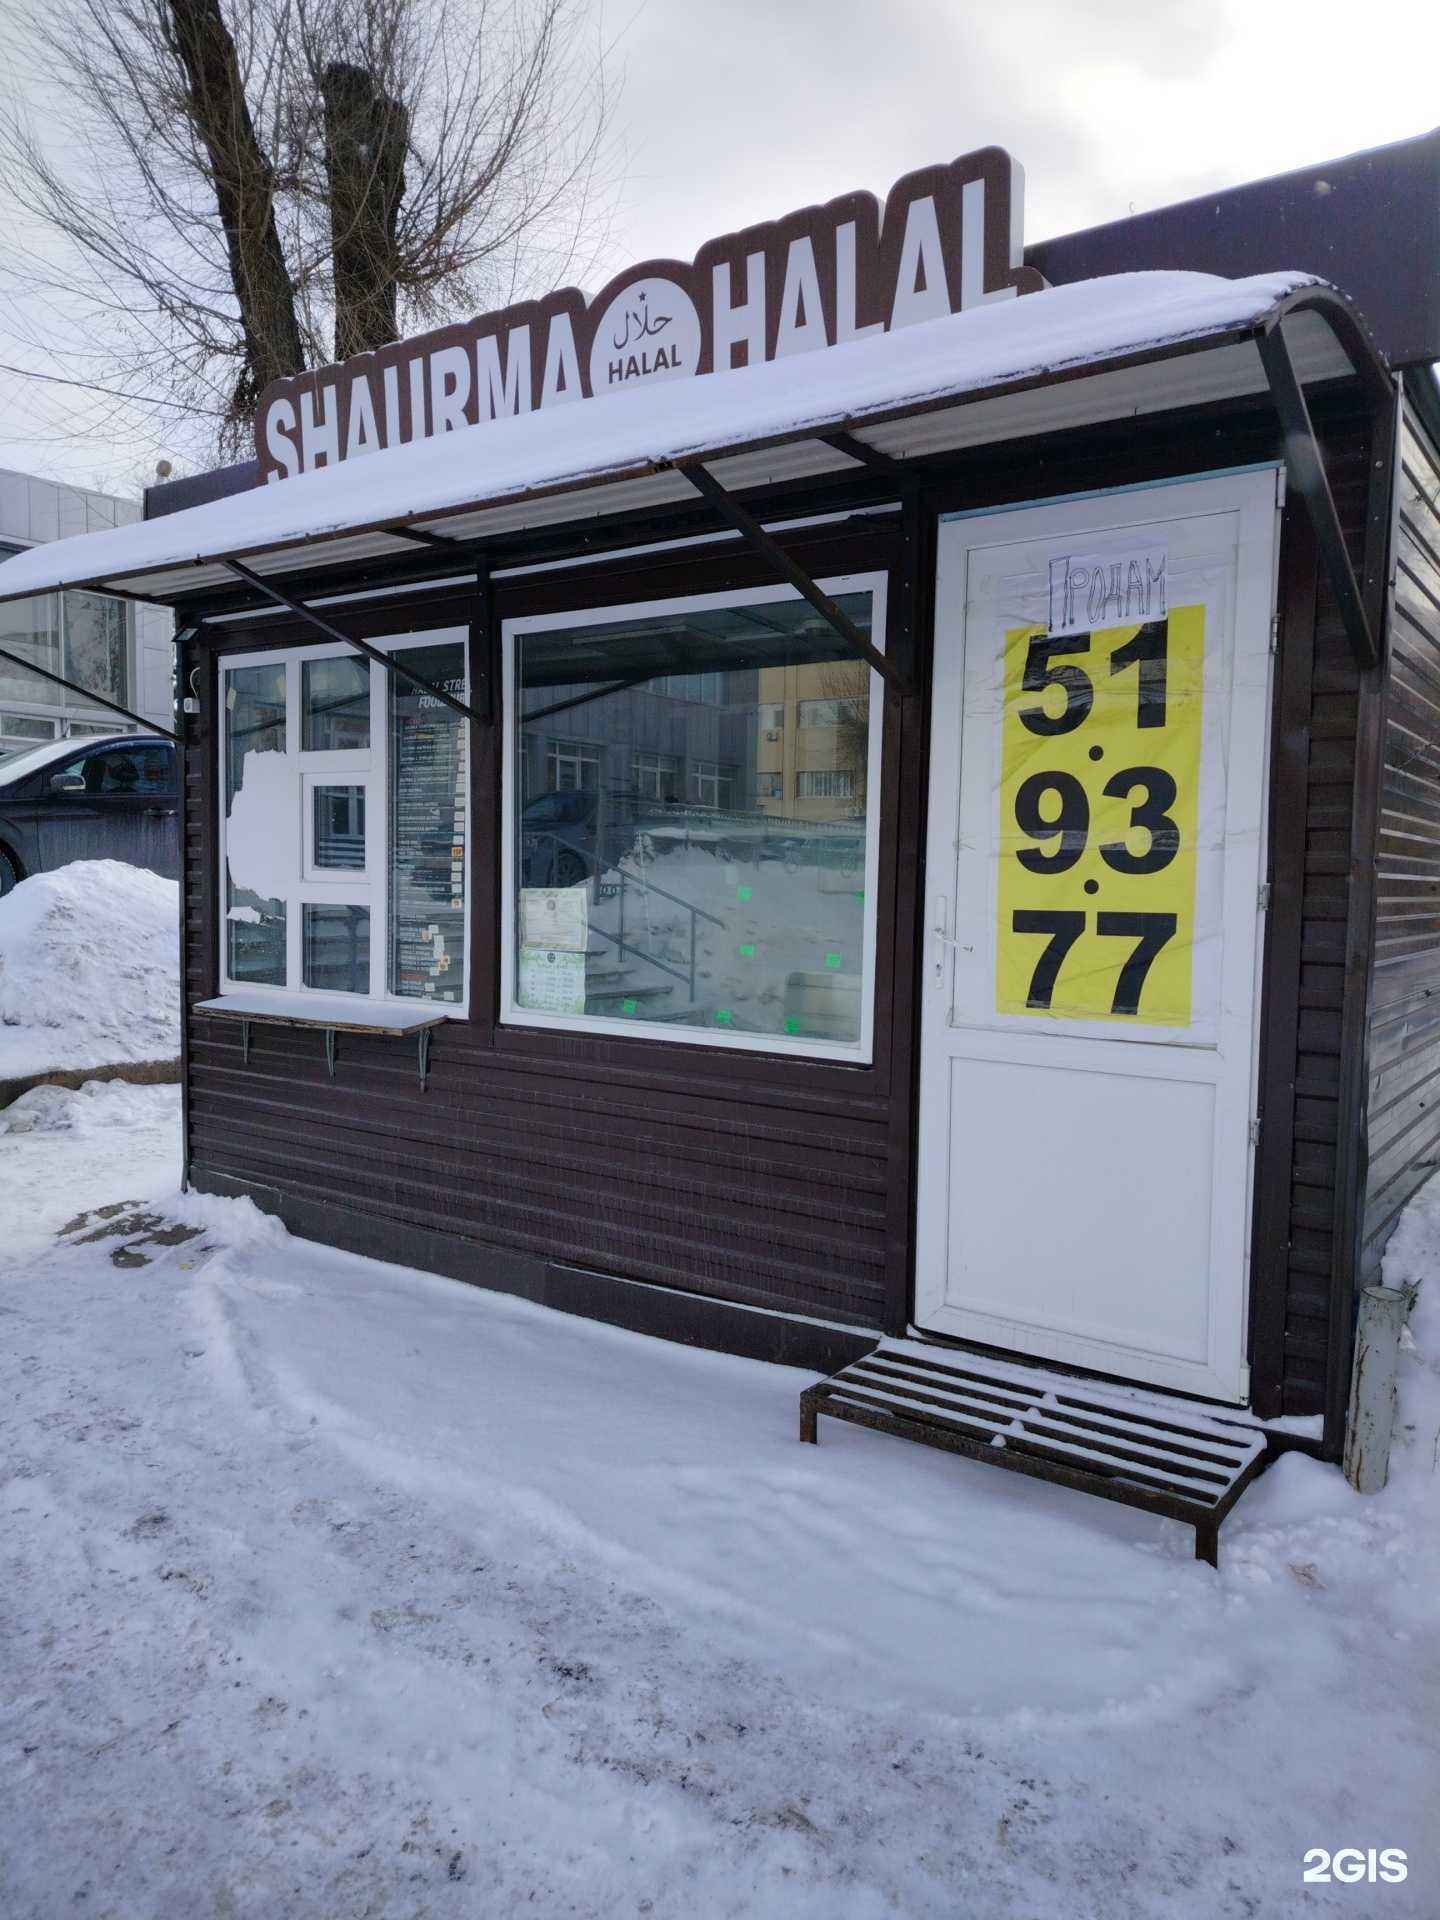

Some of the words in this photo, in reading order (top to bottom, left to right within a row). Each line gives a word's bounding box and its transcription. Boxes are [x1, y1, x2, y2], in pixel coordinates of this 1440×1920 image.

[266, 312, 584, 485] SHAURMA
[712, 178, 1018, 374] HALAL
[608, 343, 682, 385] HALAL
[613, 304, 673, 349] حلال
[1048, 555, 1166, 633] ПРОДАМ
[1012, 909, 1178, 1016] 77
